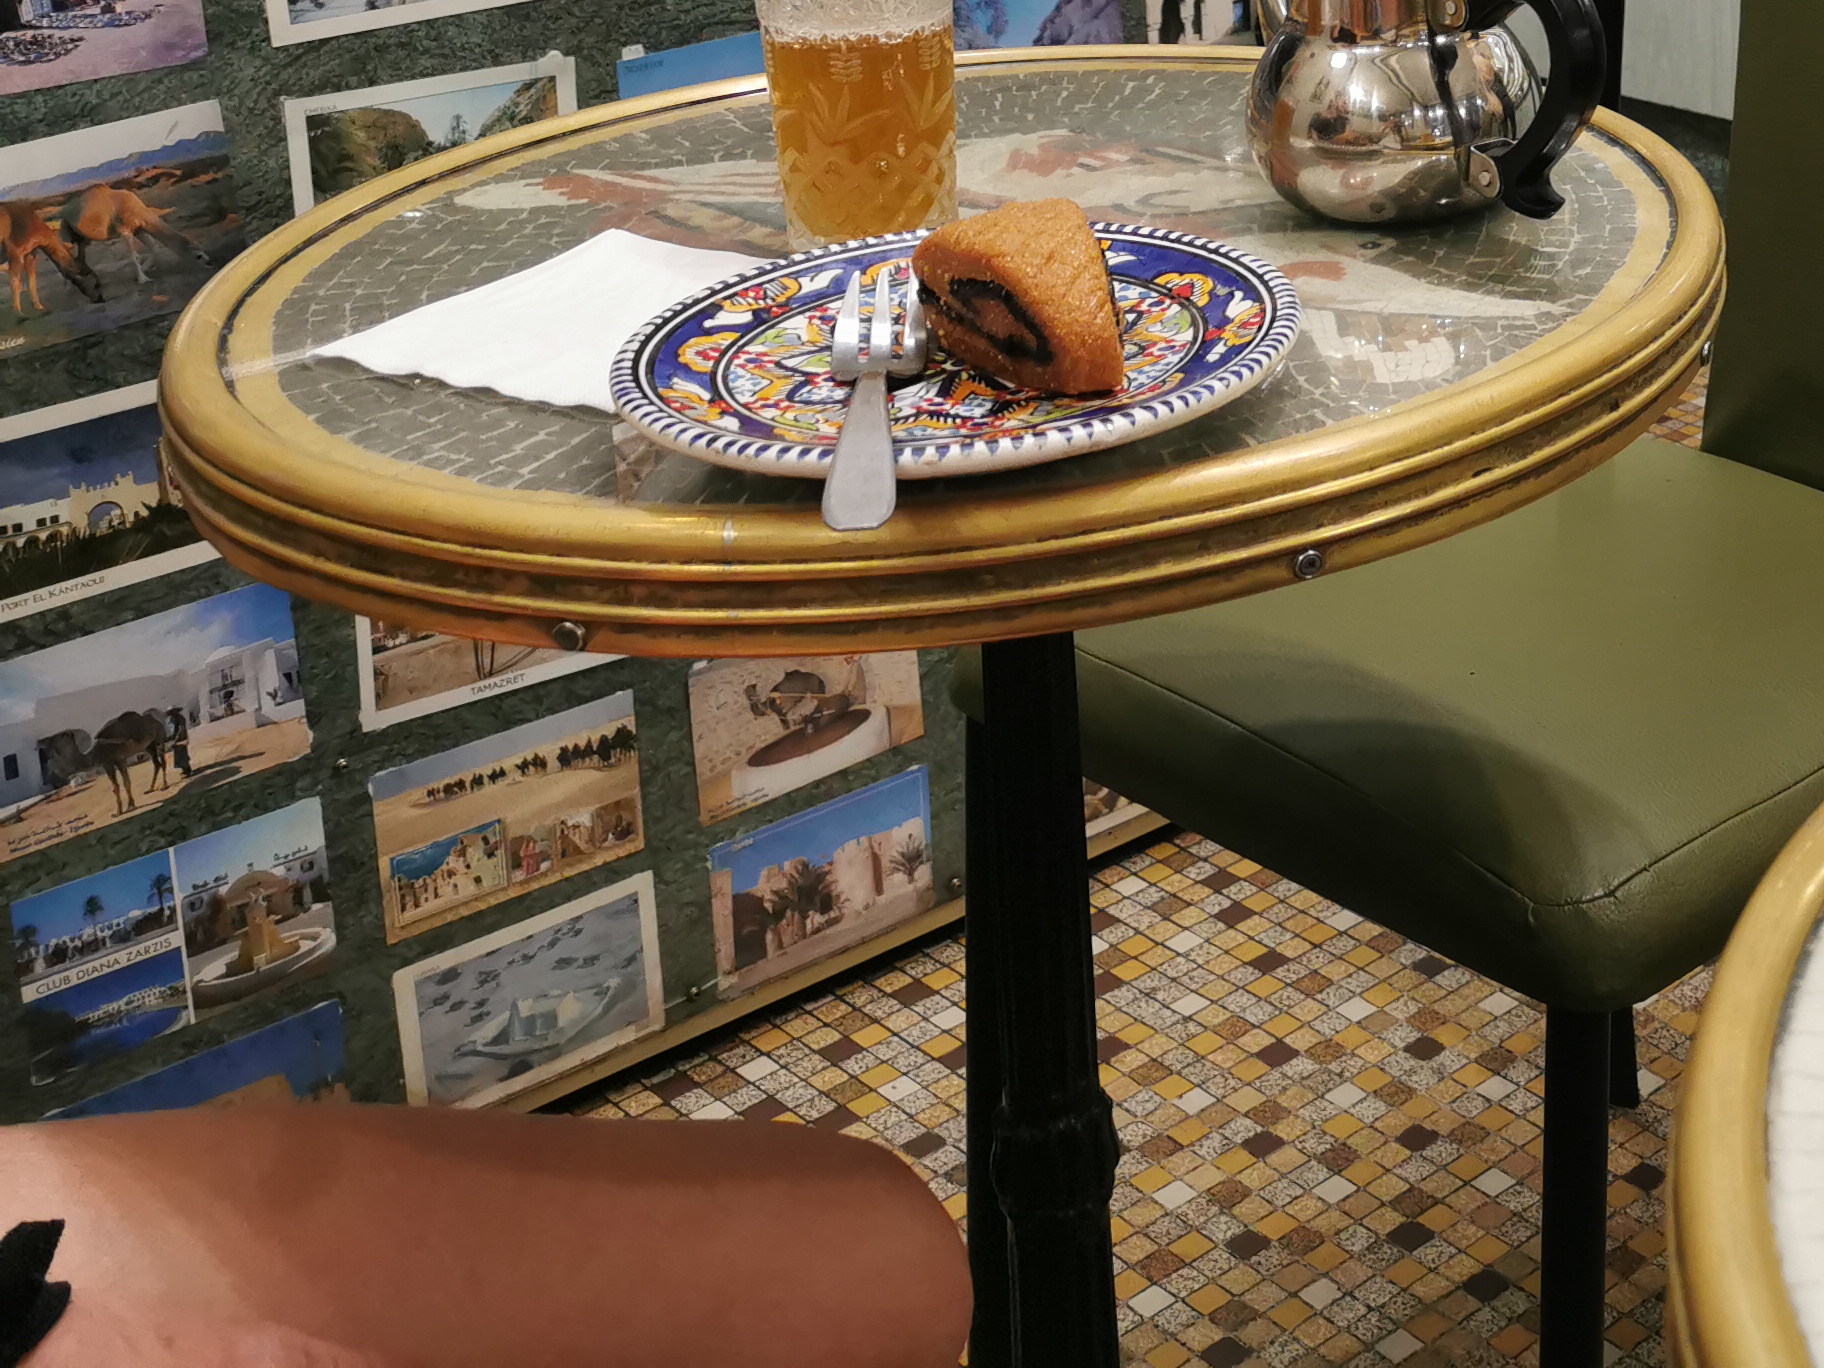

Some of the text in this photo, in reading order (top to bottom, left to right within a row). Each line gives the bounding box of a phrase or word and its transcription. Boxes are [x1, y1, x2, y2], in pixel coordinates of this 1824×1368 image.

[0, 599, 29, 613] PORT
[32, 593, 47, 604] EL
[470, 673, 526, 696] TAMAZRET
[35, 938, 172, 995] CLUB DIANA ZARZIS
